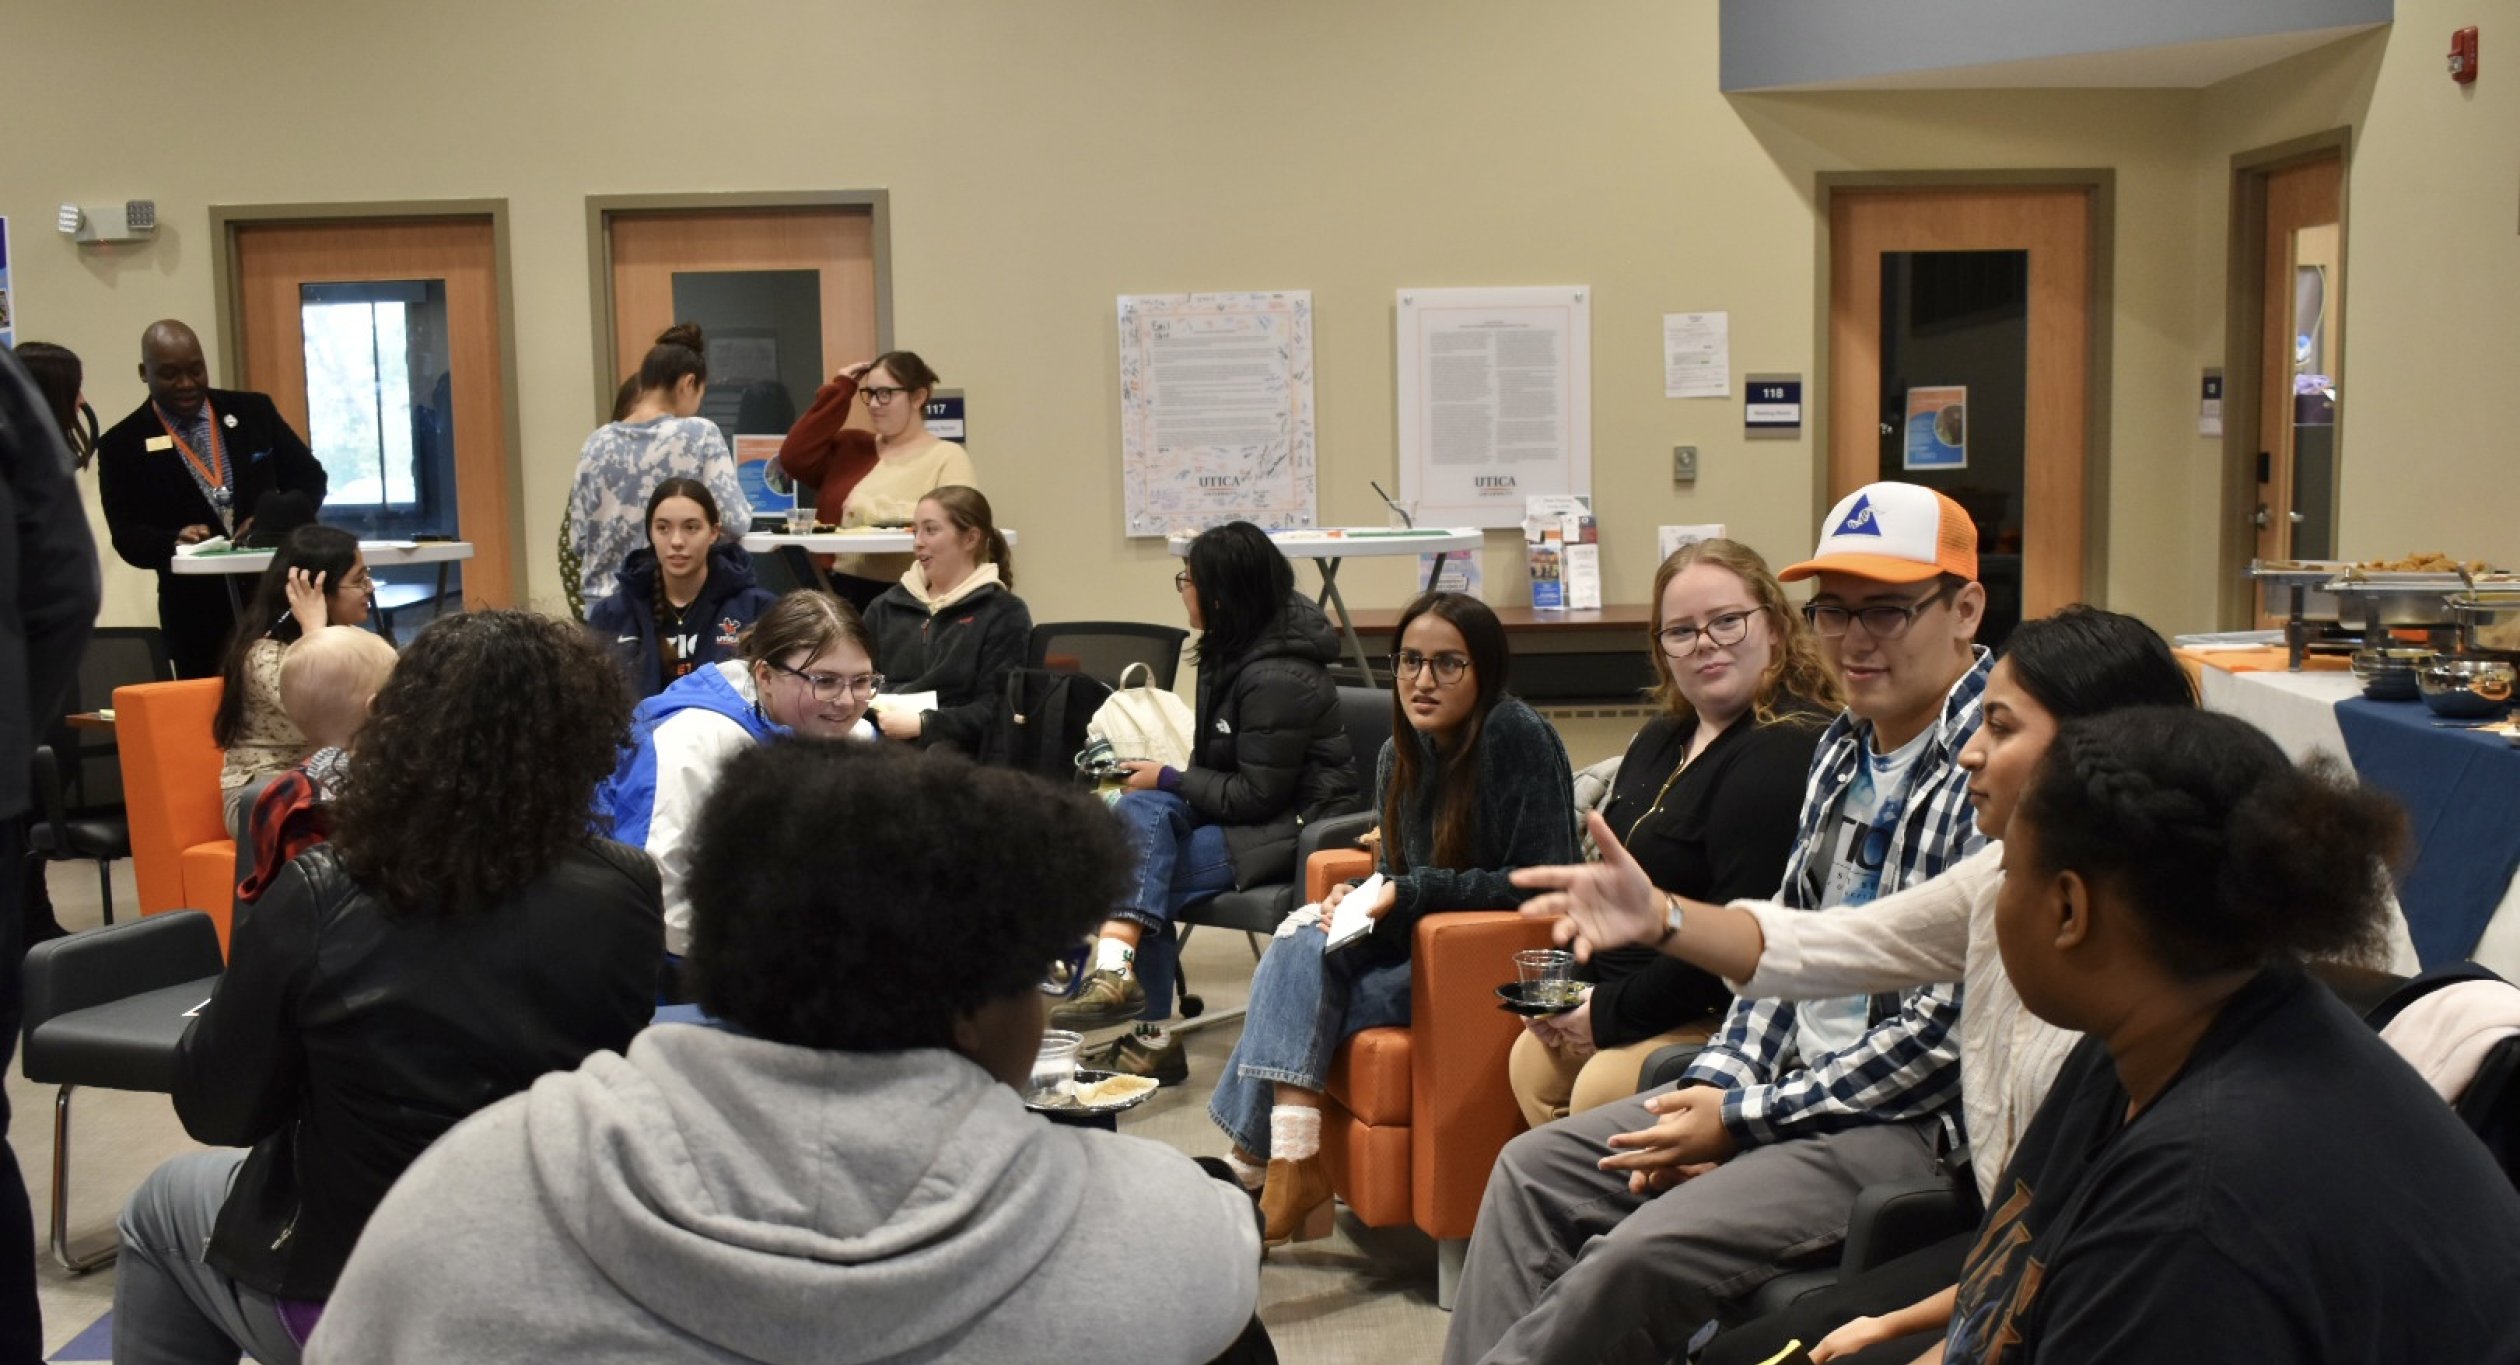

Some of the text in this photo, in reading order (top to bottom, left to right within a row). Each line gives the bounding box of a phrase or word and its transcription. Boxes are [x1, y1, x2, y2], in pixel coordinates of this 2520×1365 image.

[1762, 387, 1784, 399] 118
[926, 403, 947, 415] 117
[1198, 475, 1241, 488] UTICA
[1475, 475, 1516, 488] UTICA
